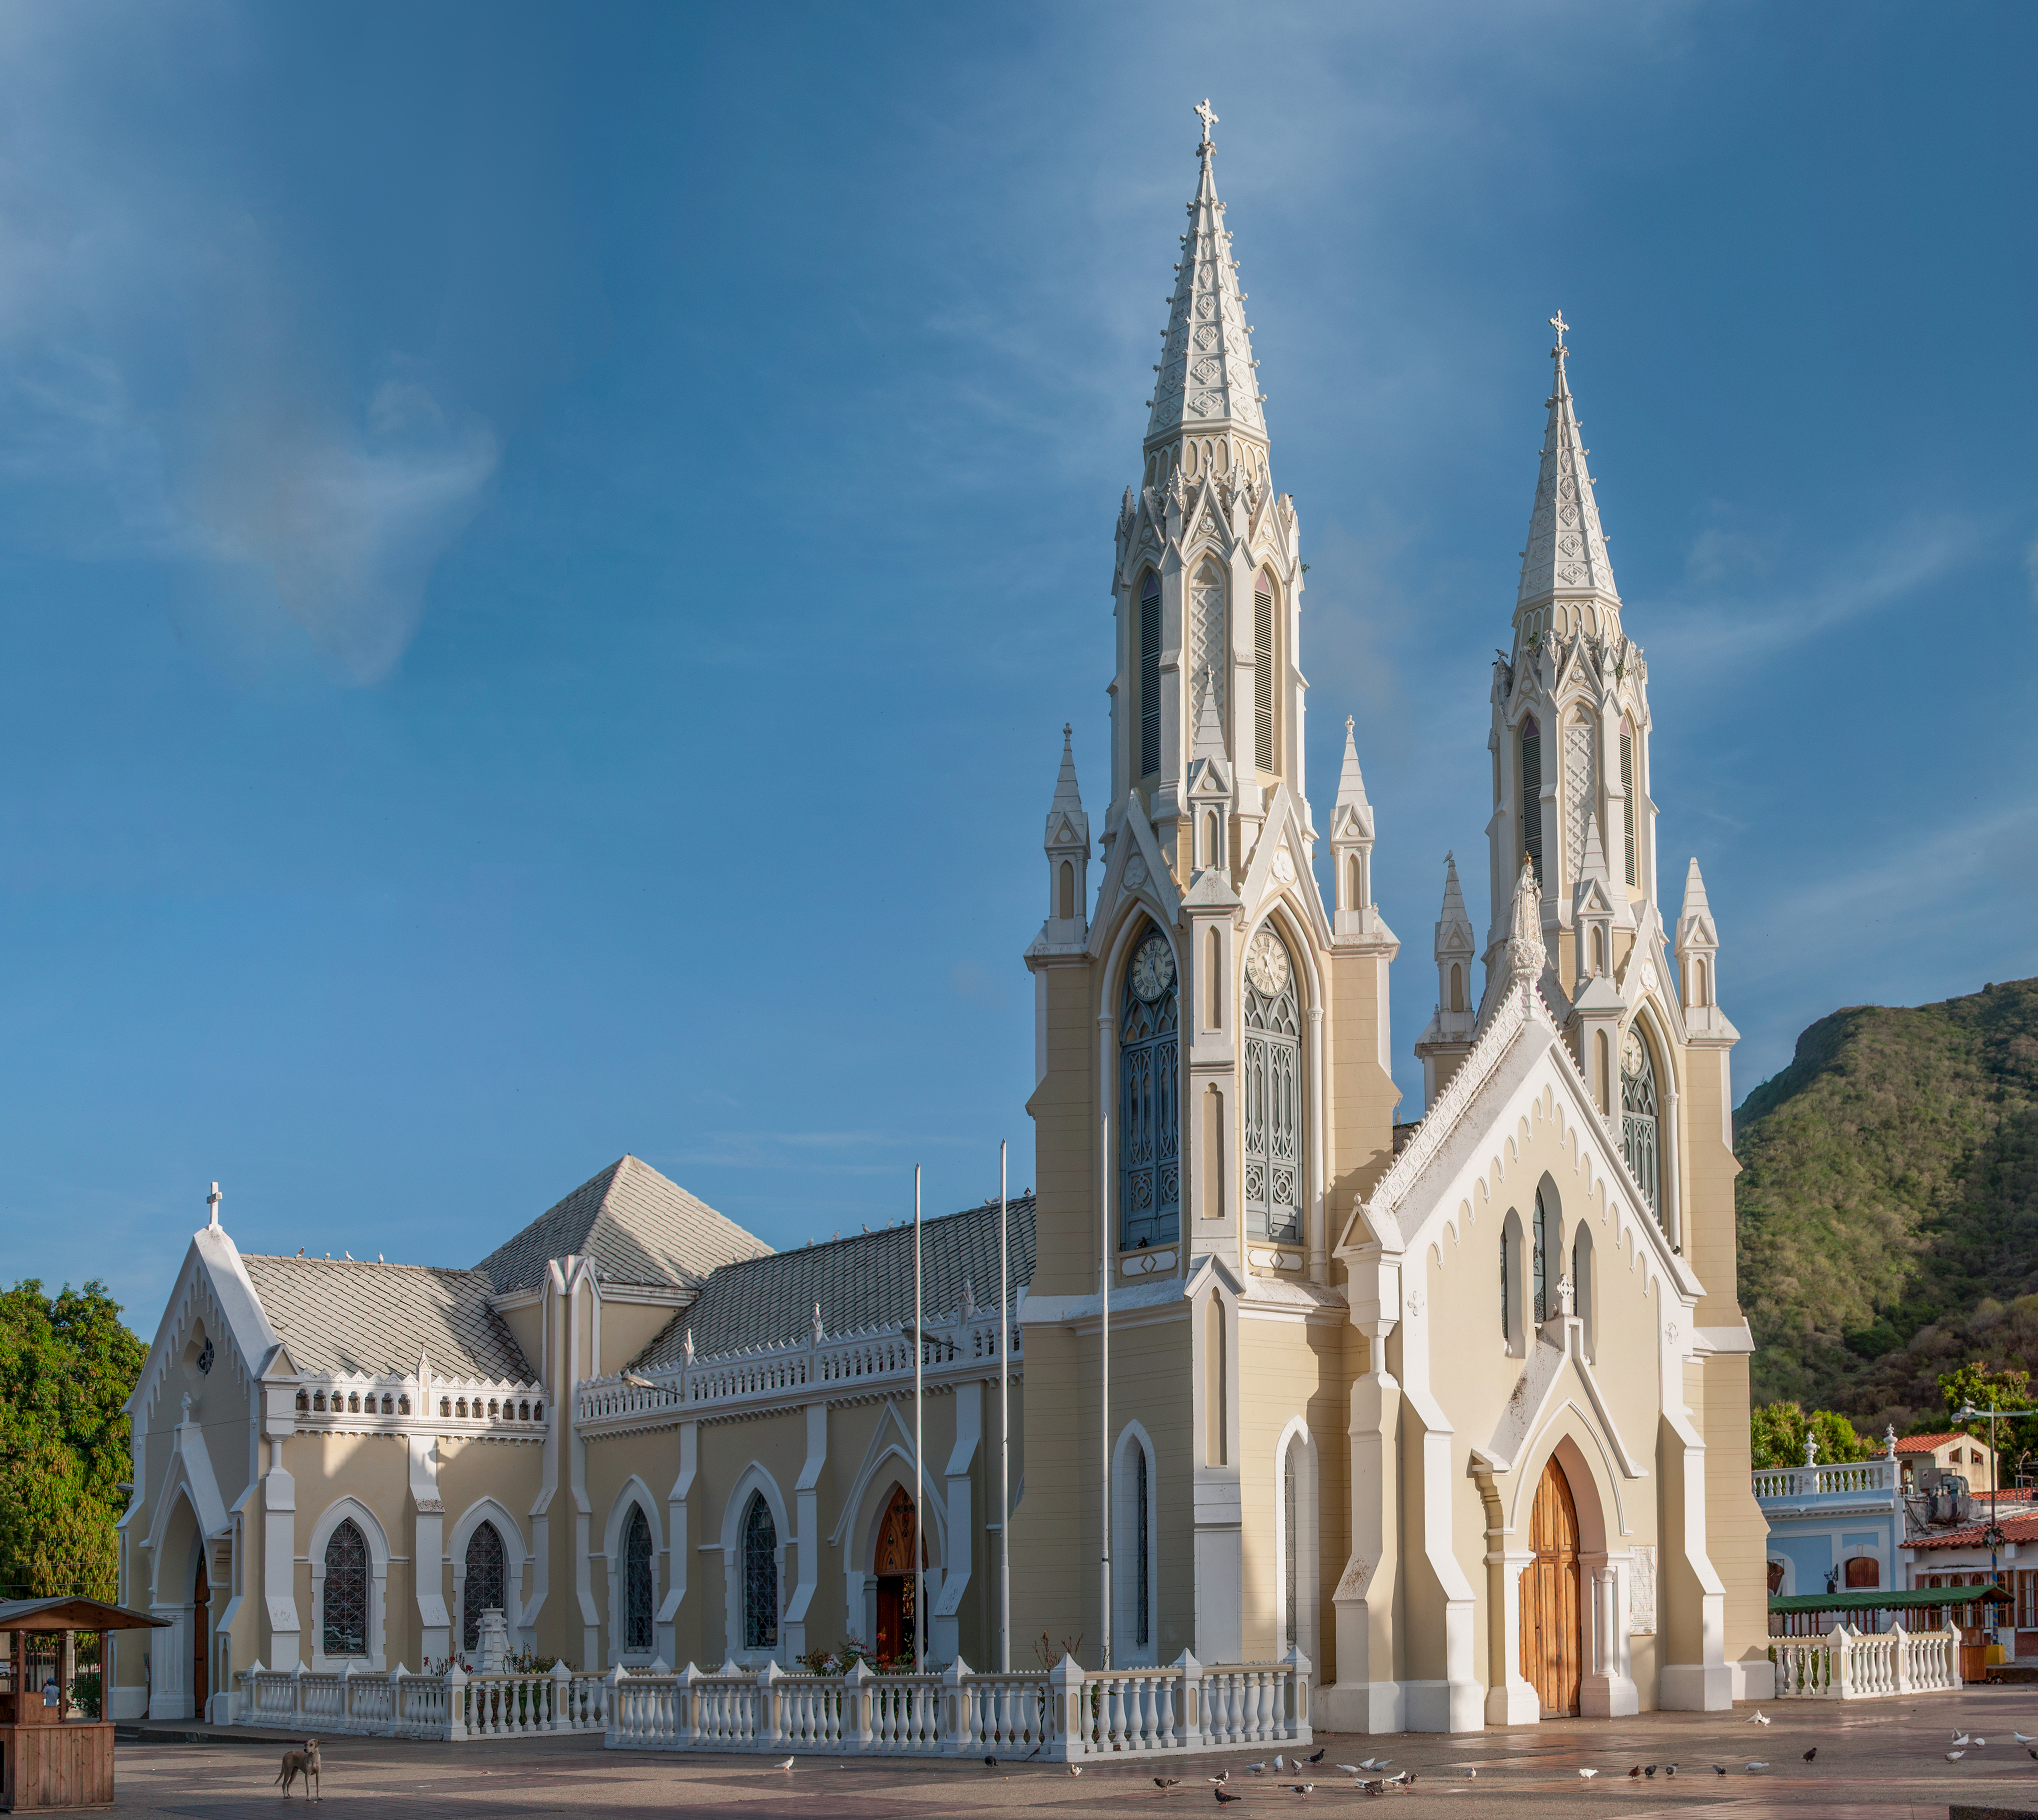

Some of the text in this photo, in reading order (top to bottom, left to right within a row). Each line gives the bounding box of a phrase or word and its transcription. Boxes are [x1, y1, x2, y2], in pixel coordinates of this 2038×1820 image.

[1255, 938, 1262, 949] XI
[1141, 948, 1148, 957] XI
[1250, 946, 1256, 954] X
[1163, 971, 1170, 979] IV
[1276, 974, 1283, 983] IV
[1150, 986, 1156, 995] VI
[1264, 981, 1269, 991] VI
